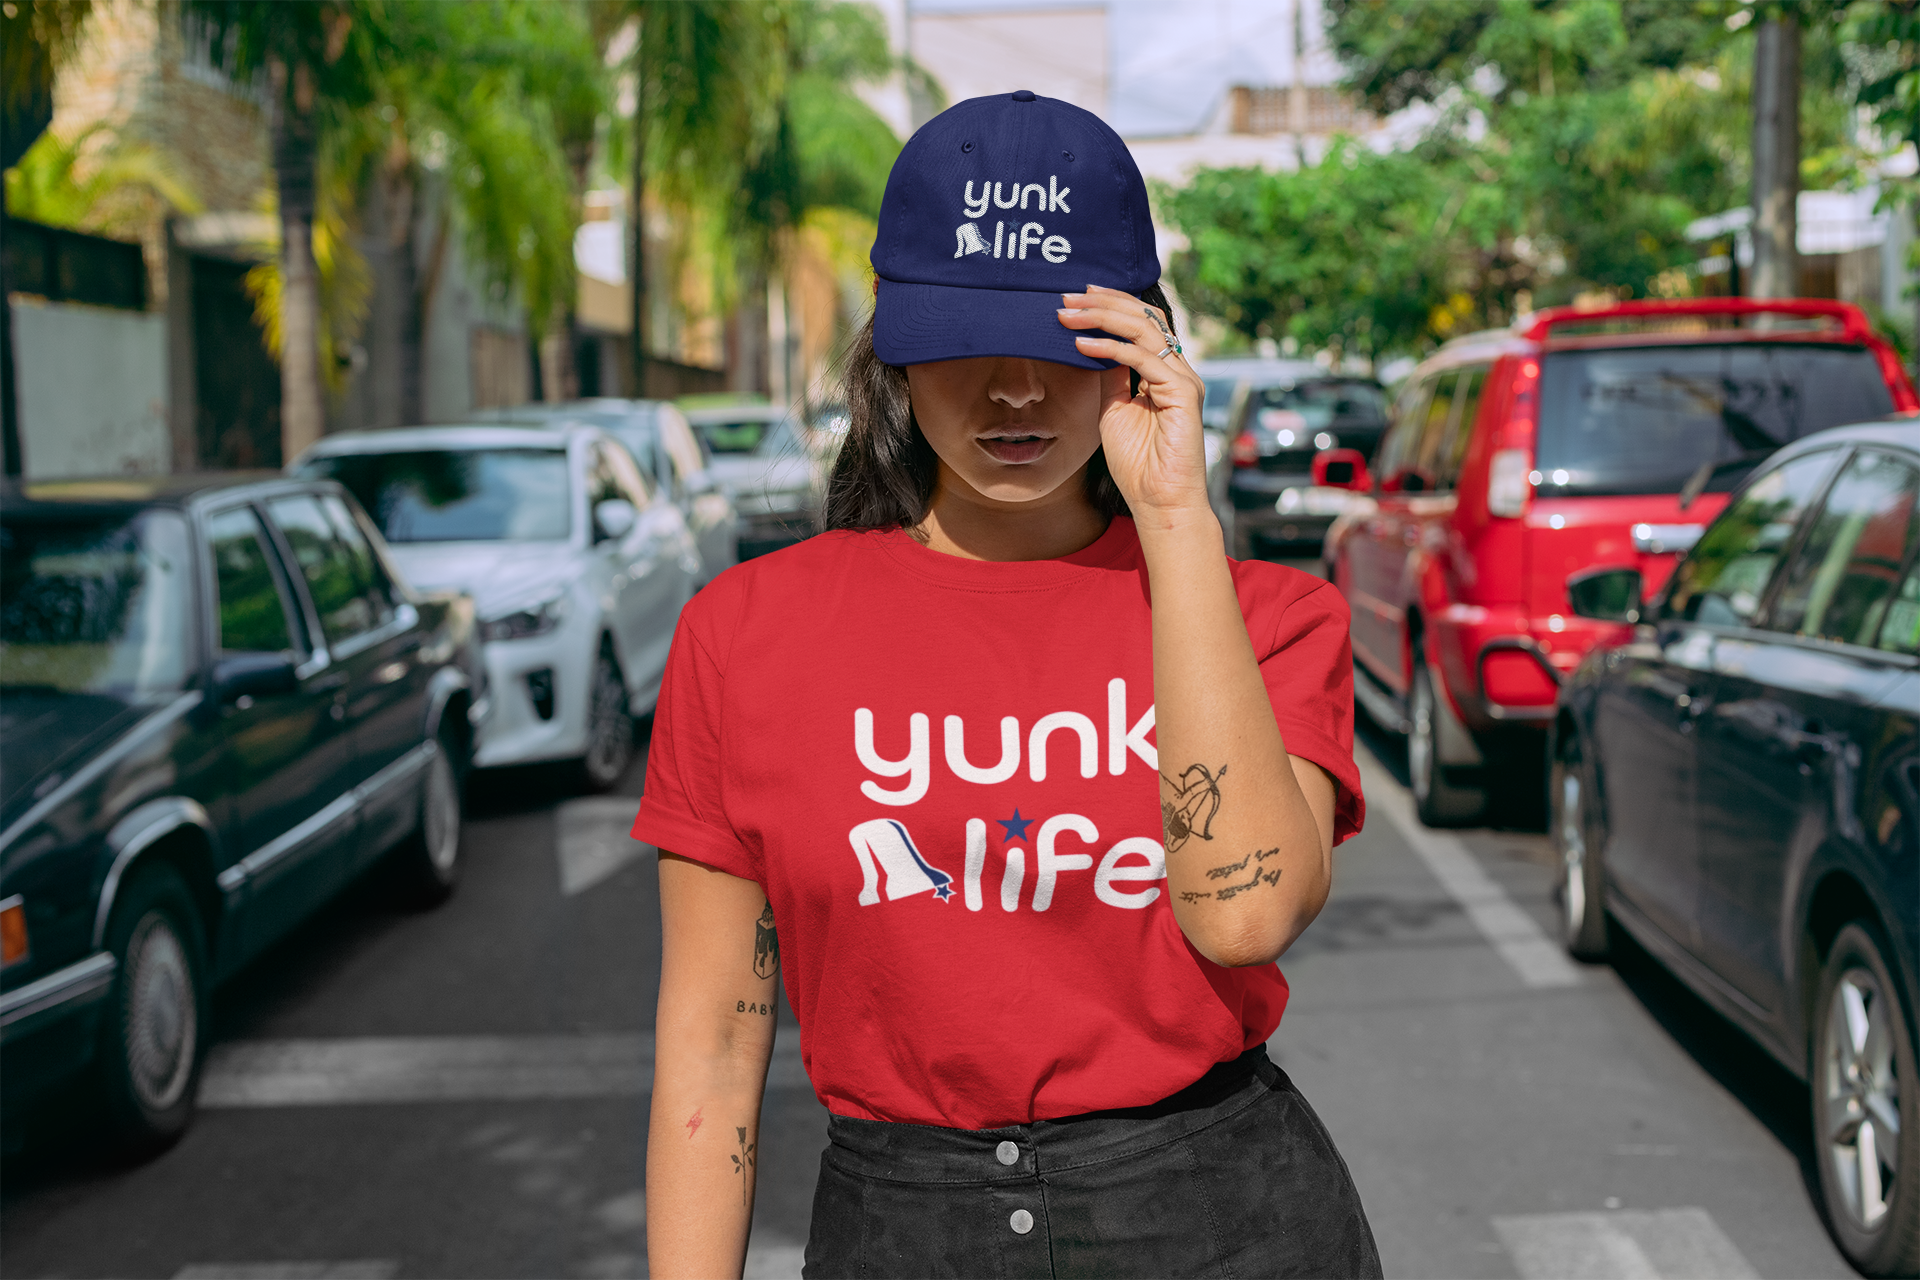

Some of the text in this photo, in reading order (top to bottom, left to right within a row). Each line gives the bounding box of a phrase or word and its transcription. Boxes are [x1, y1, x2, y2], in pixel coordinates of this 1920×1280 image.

[963, 174, 1071, 219] yunk
[993, 219, 1072, 264] life
[854, 677, 1159, 806] yunk
[963, 806, 1167, 912] life
[736, 1000, 776, 1016] BABY
